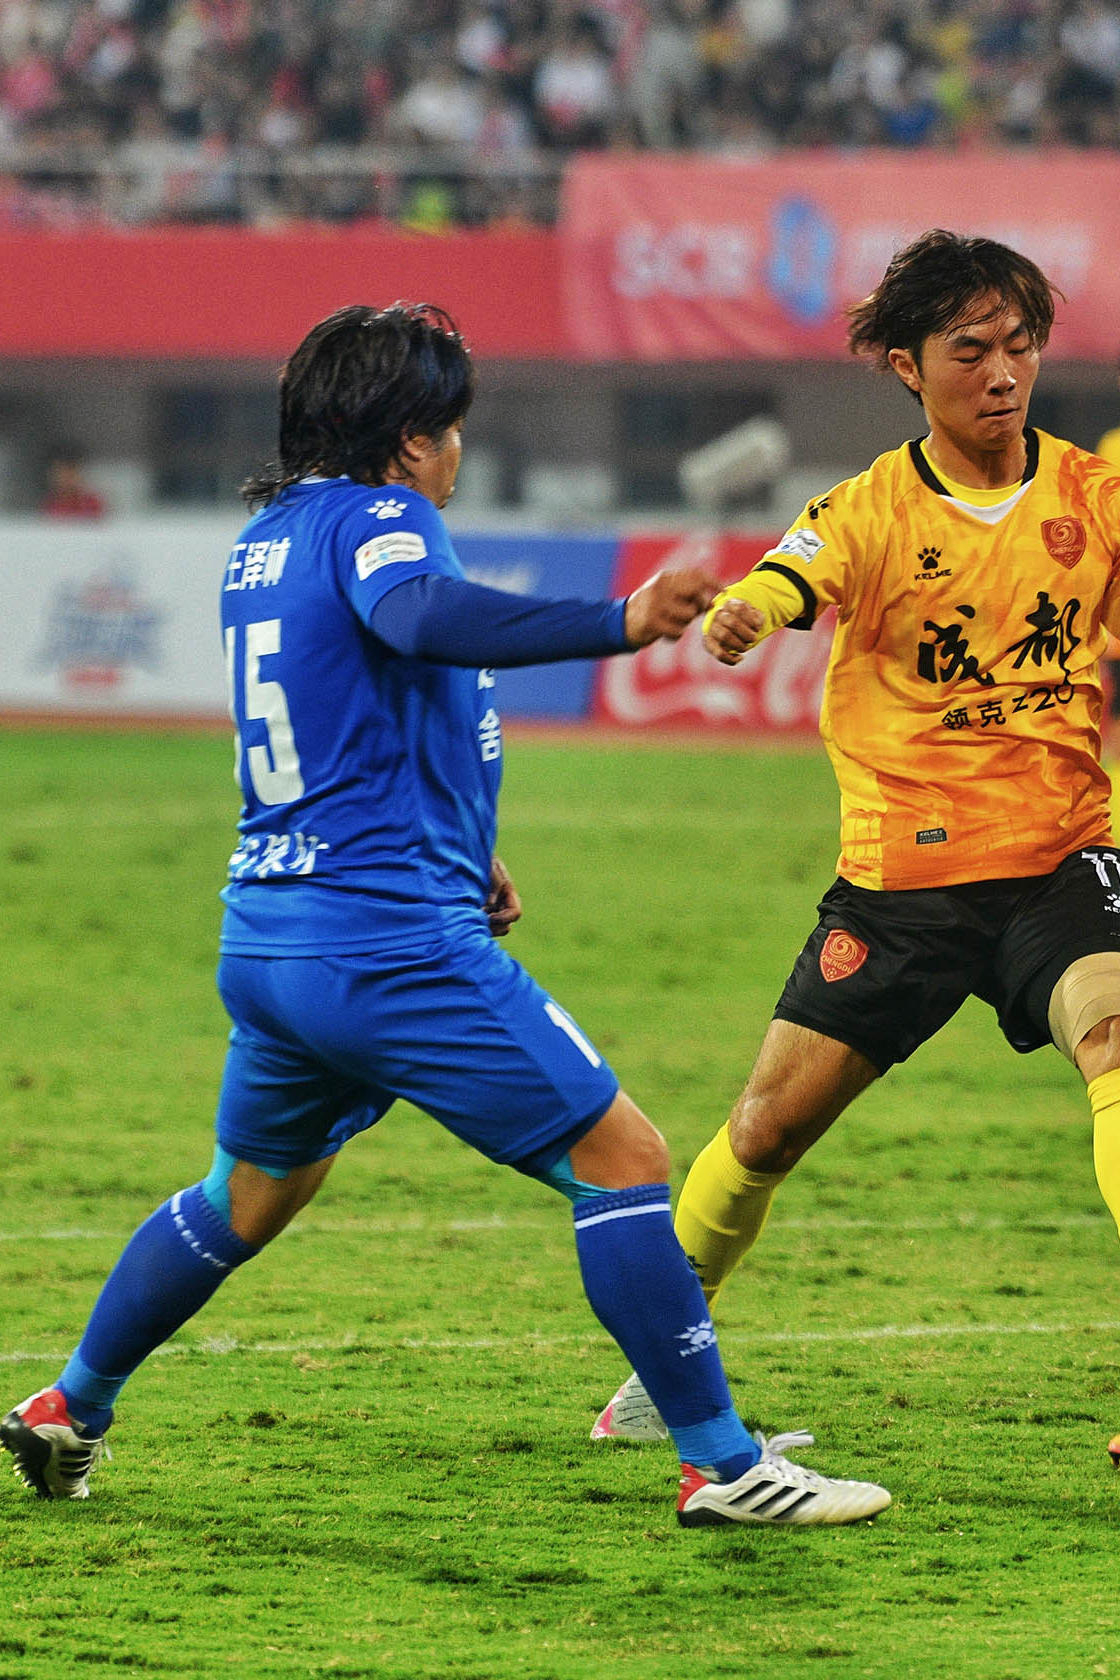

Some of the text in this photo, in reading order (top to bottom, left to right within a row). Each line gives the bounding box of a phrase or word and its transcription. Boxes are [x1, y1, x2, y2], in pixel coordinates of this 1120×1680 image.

[914, 568, 952, 582] KELME
[917, 591, 1081, 686] 成都
[224, 618, 305, 806] 15
